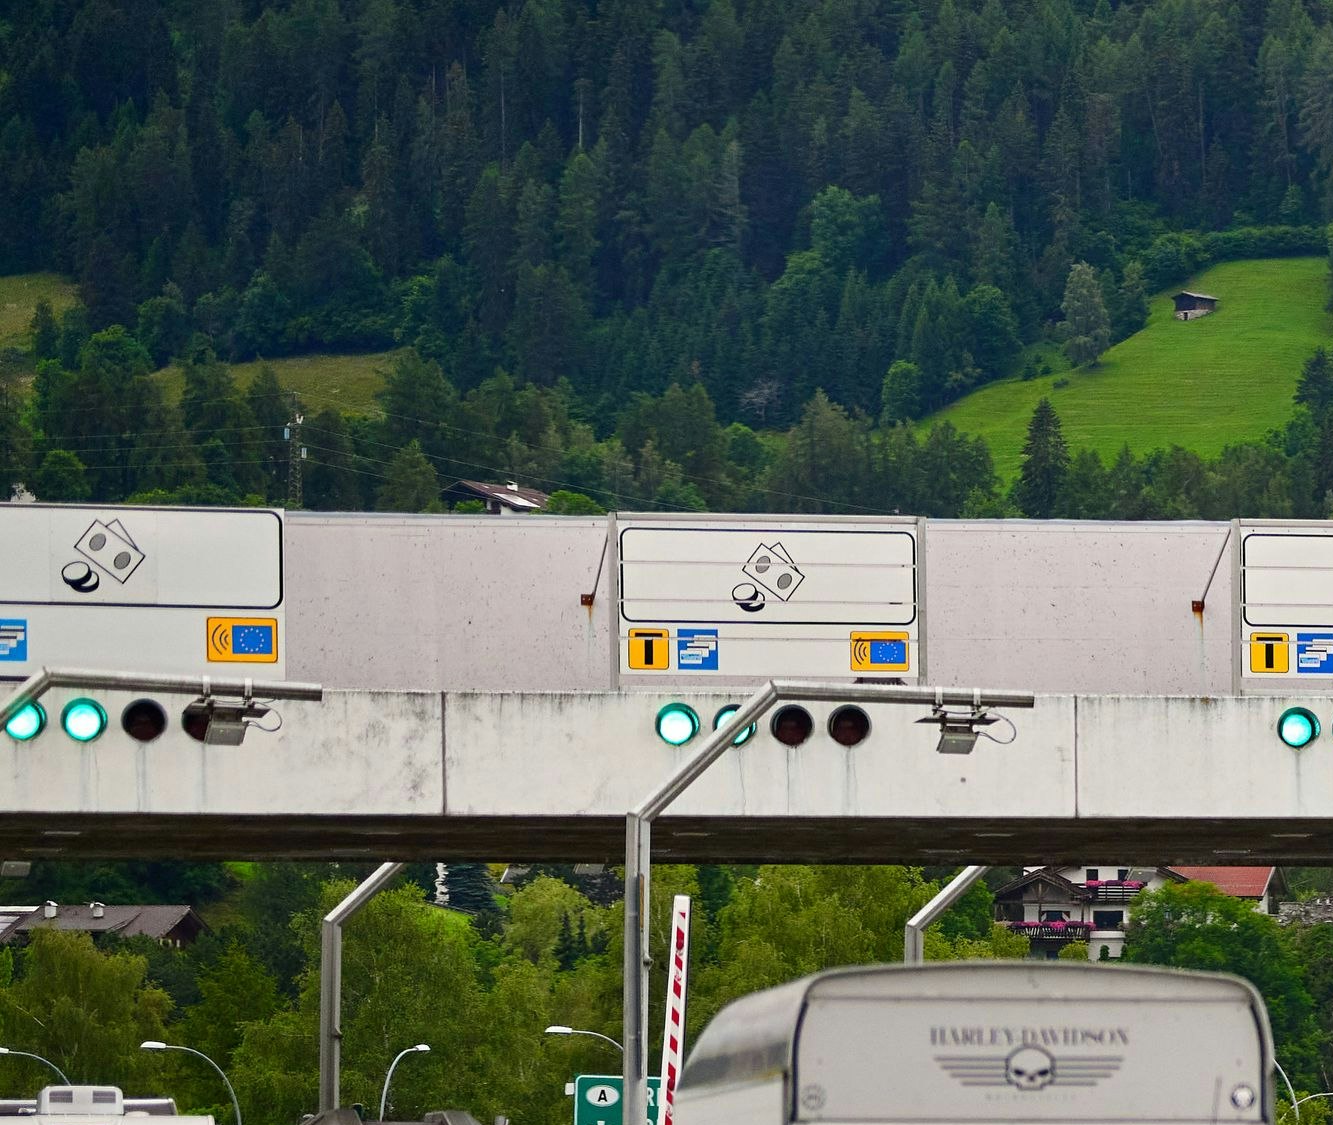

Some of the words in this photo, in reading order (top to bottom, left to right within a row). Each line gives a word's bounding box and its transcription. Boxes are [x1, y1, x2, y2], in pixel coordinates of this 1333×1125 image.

[635, 633, 662, 665] T
[1256, 637, 1283, 668] T
[598, 1090, 608, 1102] A
